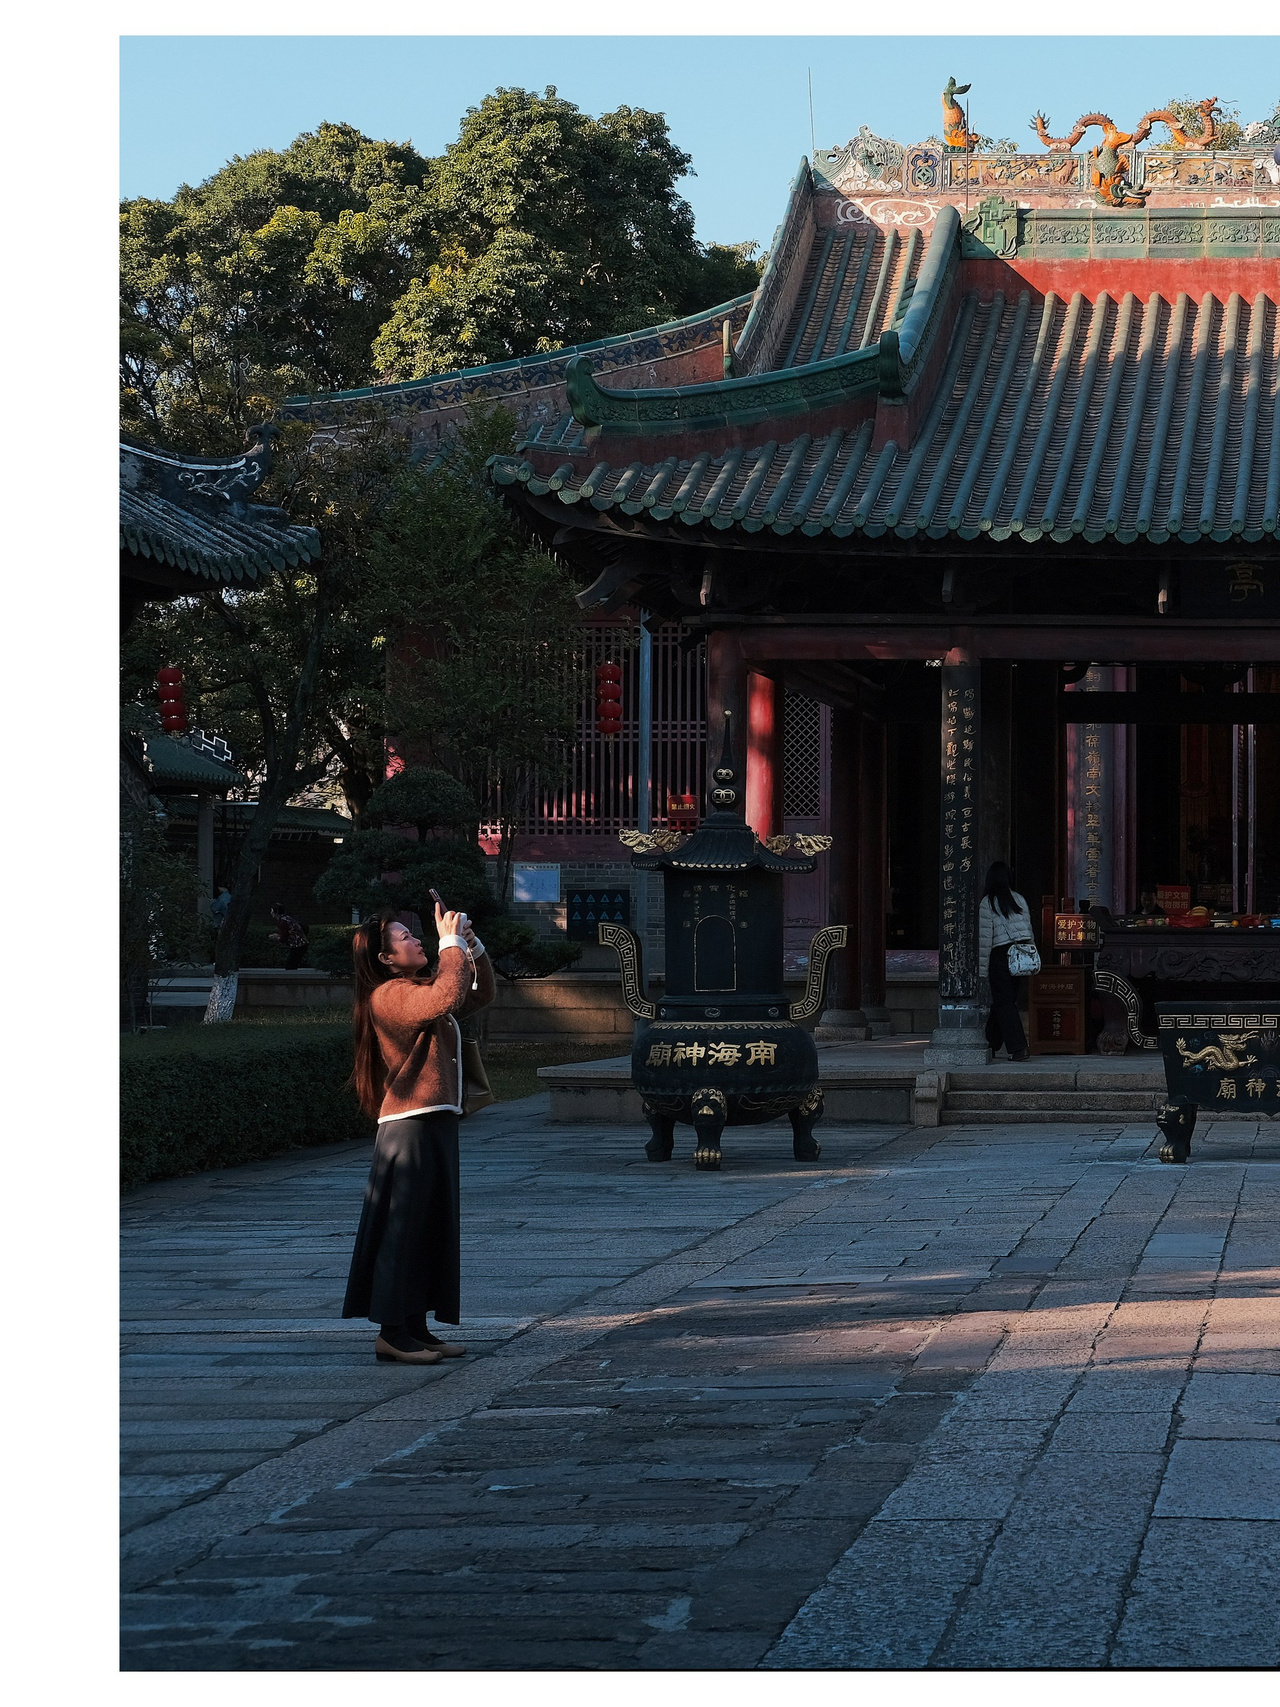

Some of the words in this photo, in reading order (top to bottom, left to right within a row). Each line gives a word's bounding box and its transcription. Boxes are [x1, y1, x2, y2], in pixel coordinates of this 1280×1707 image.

[1057, 919, 1097, 930] 爱护文物
[1057, 931, 1097, 942] 禁止攀爬
[645, 1039, 778, 1068] 南海神廟
